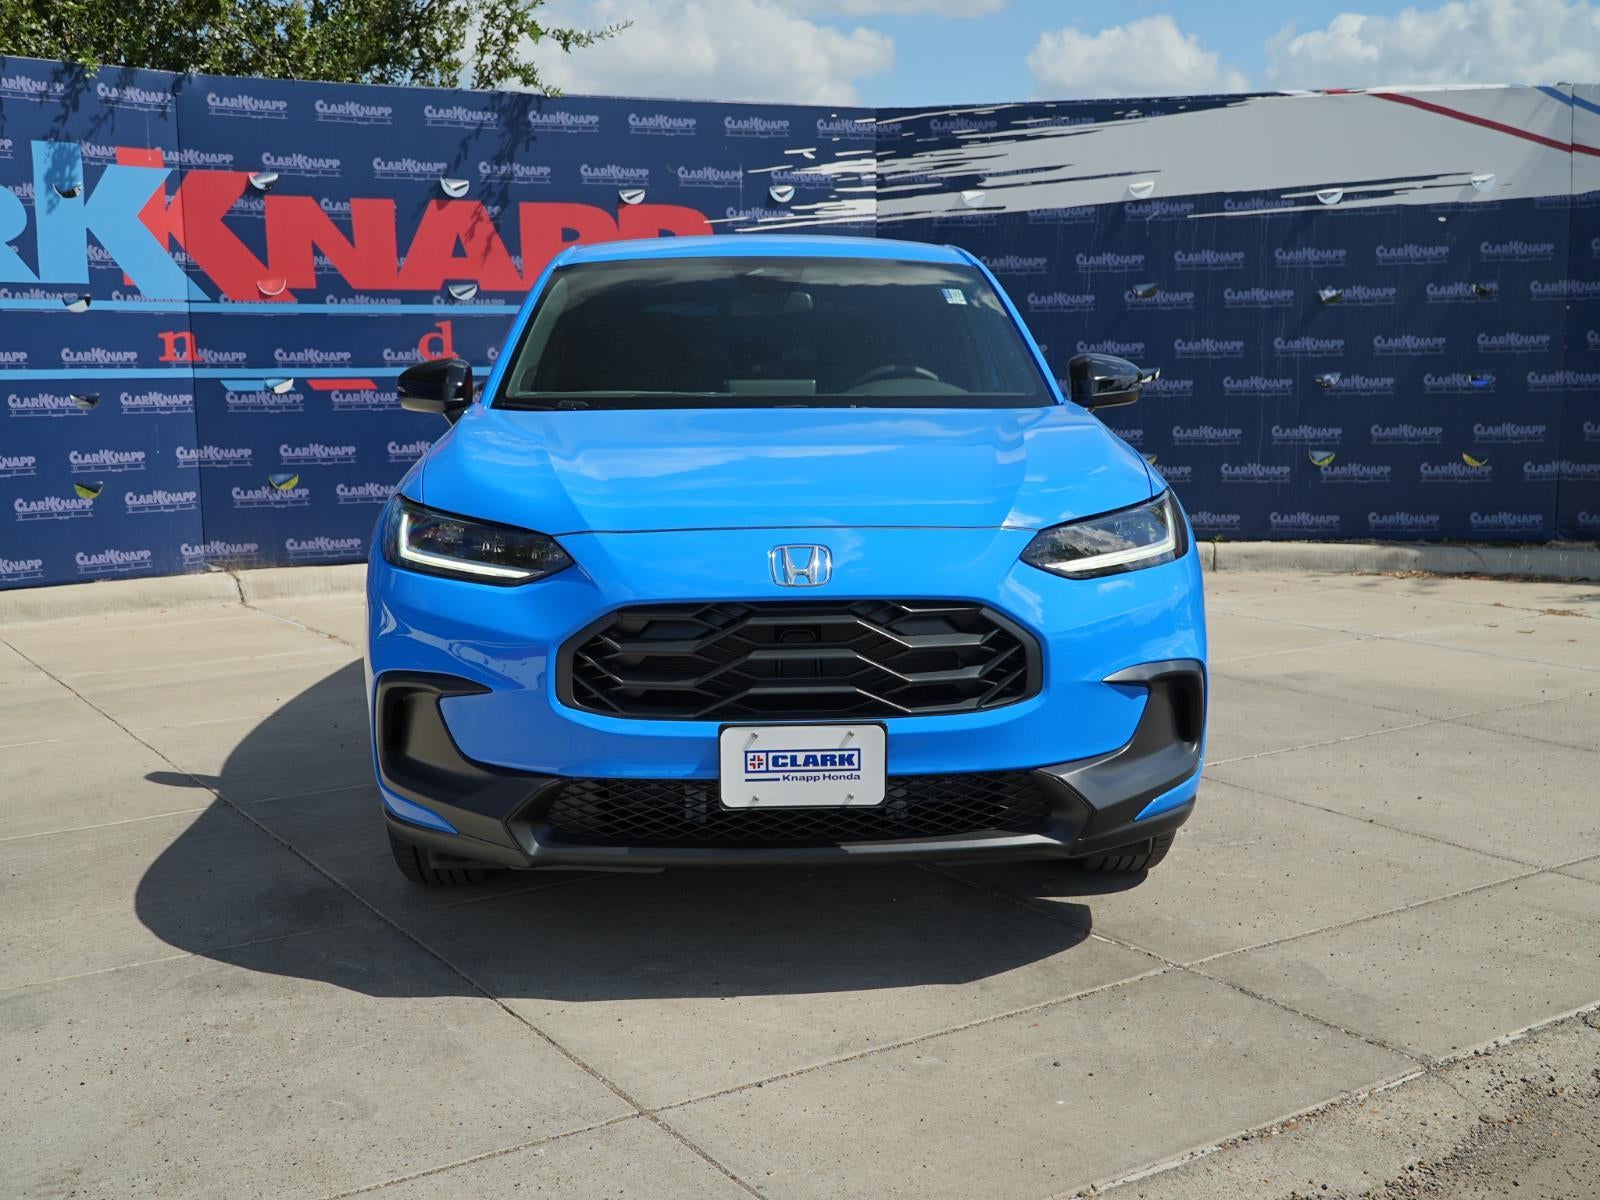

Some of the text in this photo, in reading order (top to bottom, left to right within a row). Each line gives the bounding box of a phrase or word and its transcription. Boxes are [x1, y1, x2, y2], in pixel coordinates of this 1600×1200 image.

[771, 753, 855, 768] CLARK
[782, 773, 860, 783] Knapp Honda
